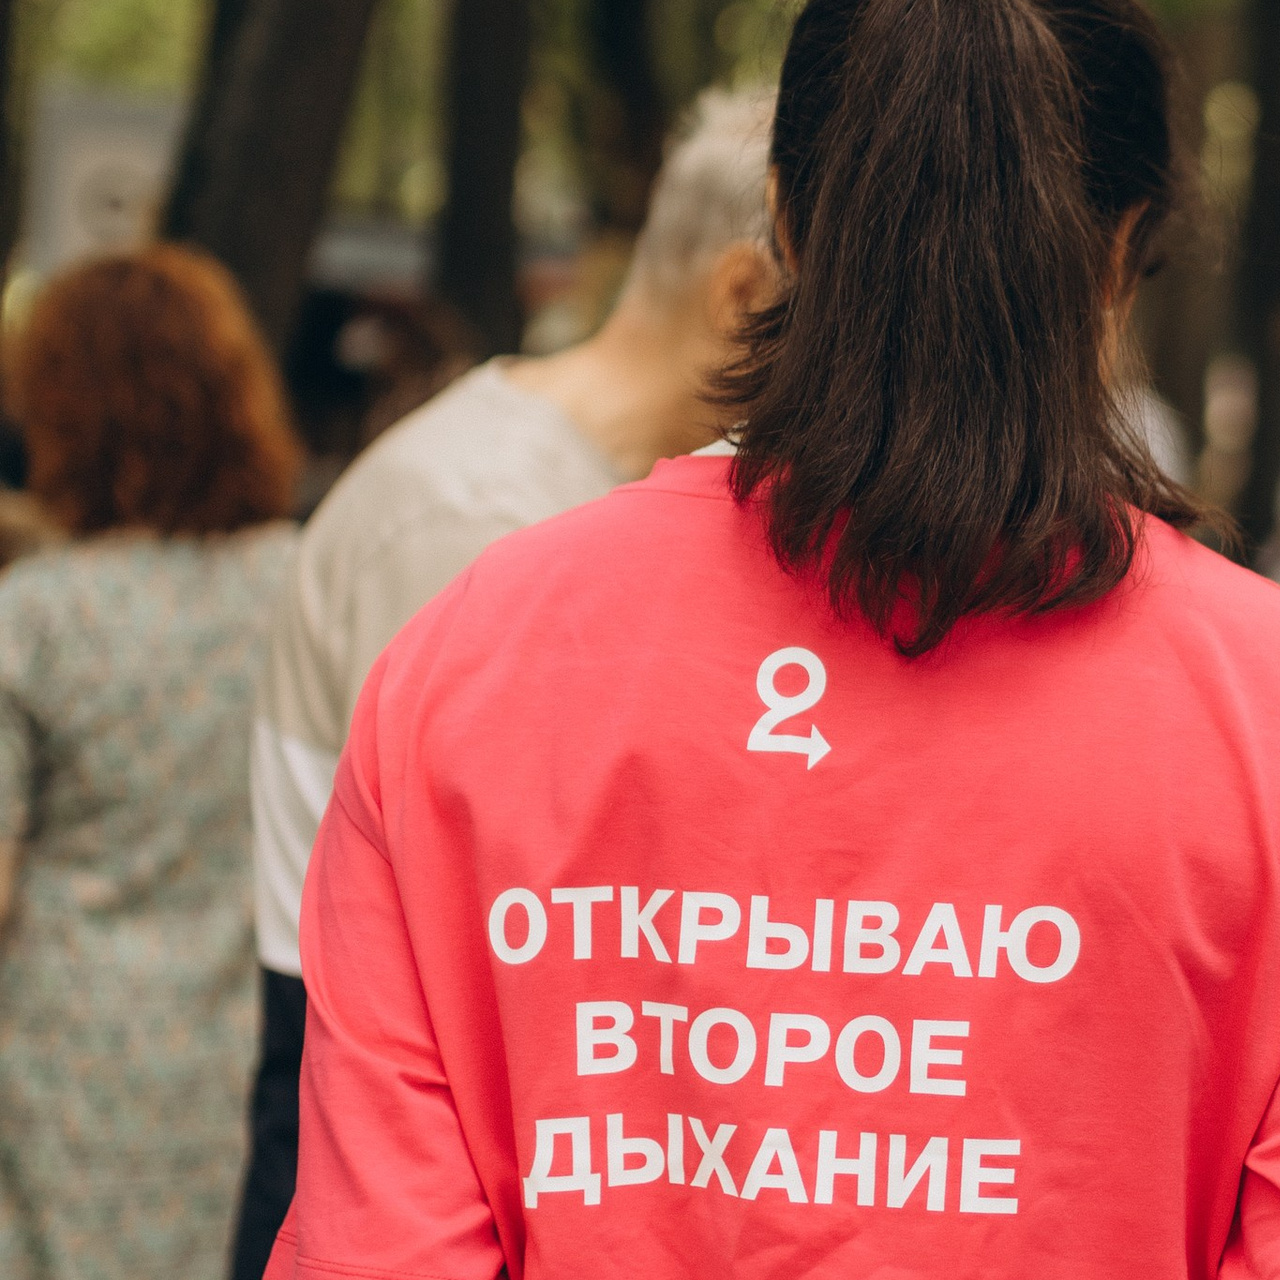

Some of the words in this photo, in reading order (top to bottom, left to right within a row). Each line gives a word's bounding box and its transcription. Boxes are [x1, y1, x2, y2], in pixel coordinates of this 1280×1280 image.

[488, 884, 1081, 984] ОТКРЫВАЮ
[575, 1000, 971, 1097] ВТОРОЕ
[522, 1112, 1021, 1215] ДЫХАНИЕ
